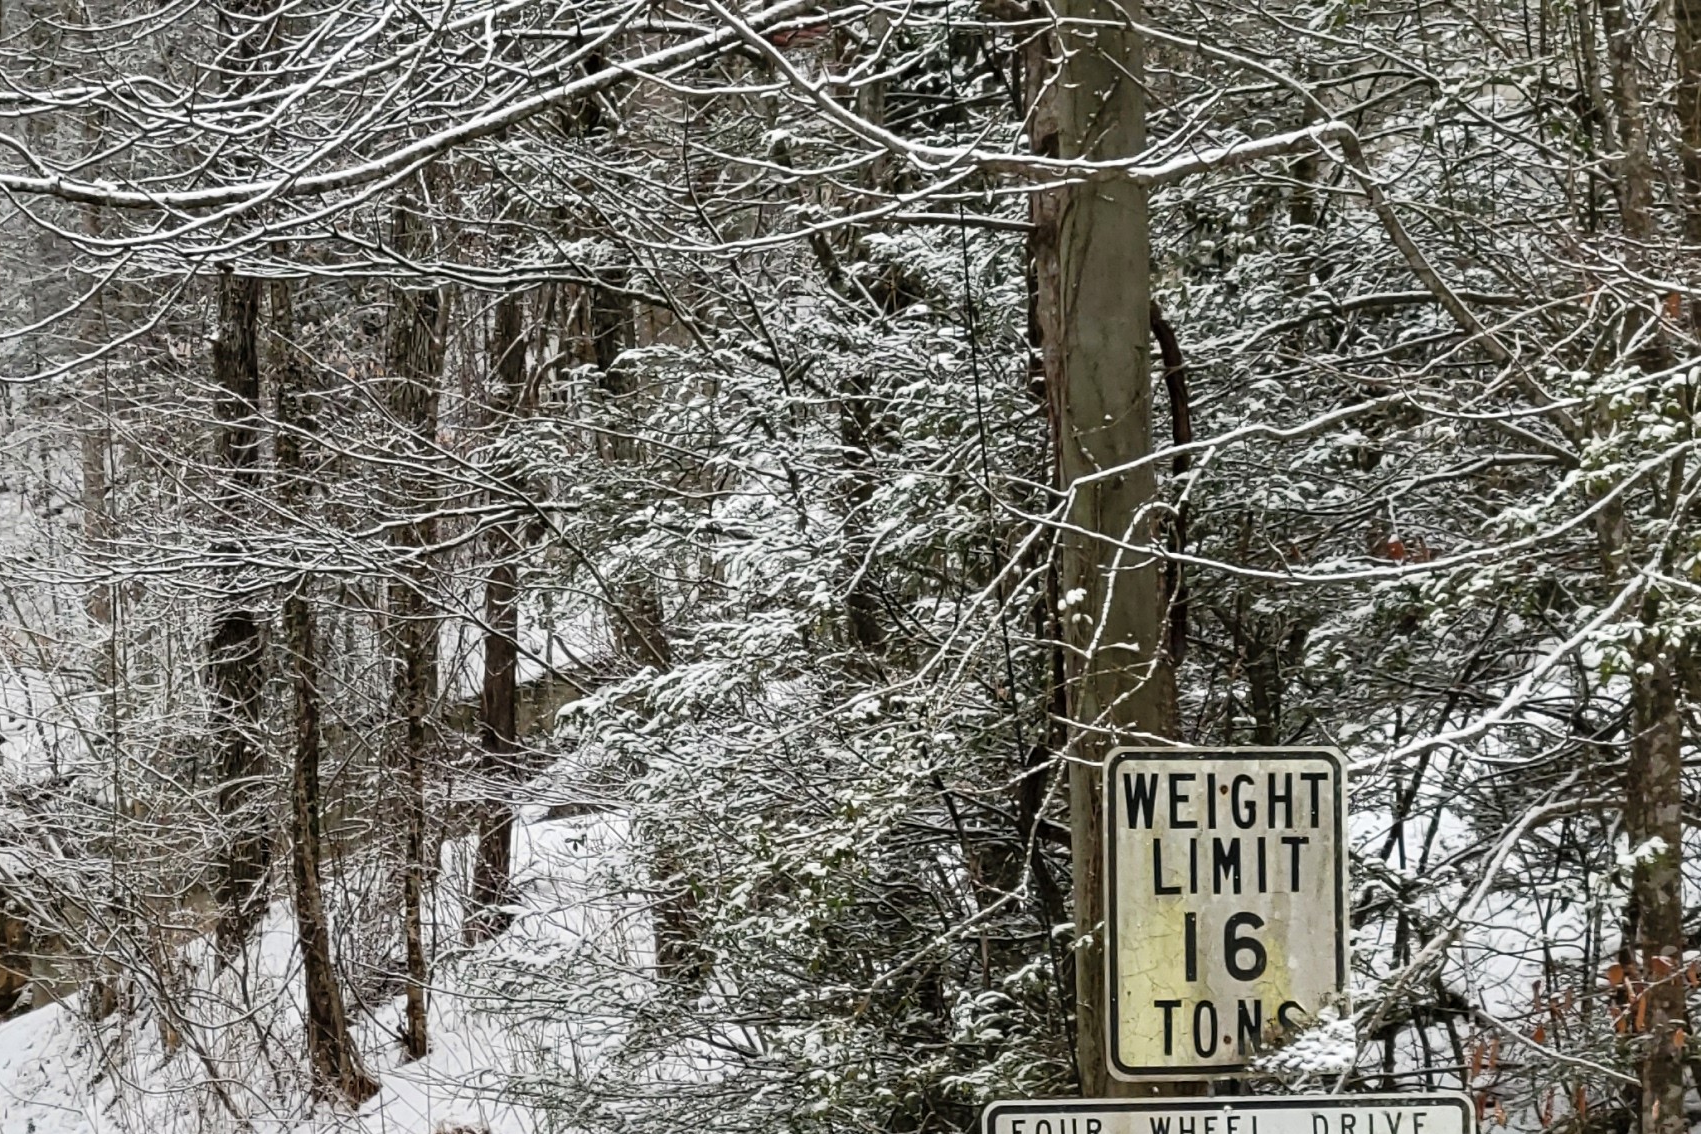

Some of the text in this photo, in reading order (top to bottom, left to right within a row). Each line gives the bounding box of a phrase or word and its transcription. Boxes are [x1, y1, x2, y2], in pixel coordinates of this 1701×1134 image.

[1122, 772, 1329, 830] WEIGHT
[1152, 836, 1310, 896] LIMIT
[1184, 911, 1268, 983] 16
